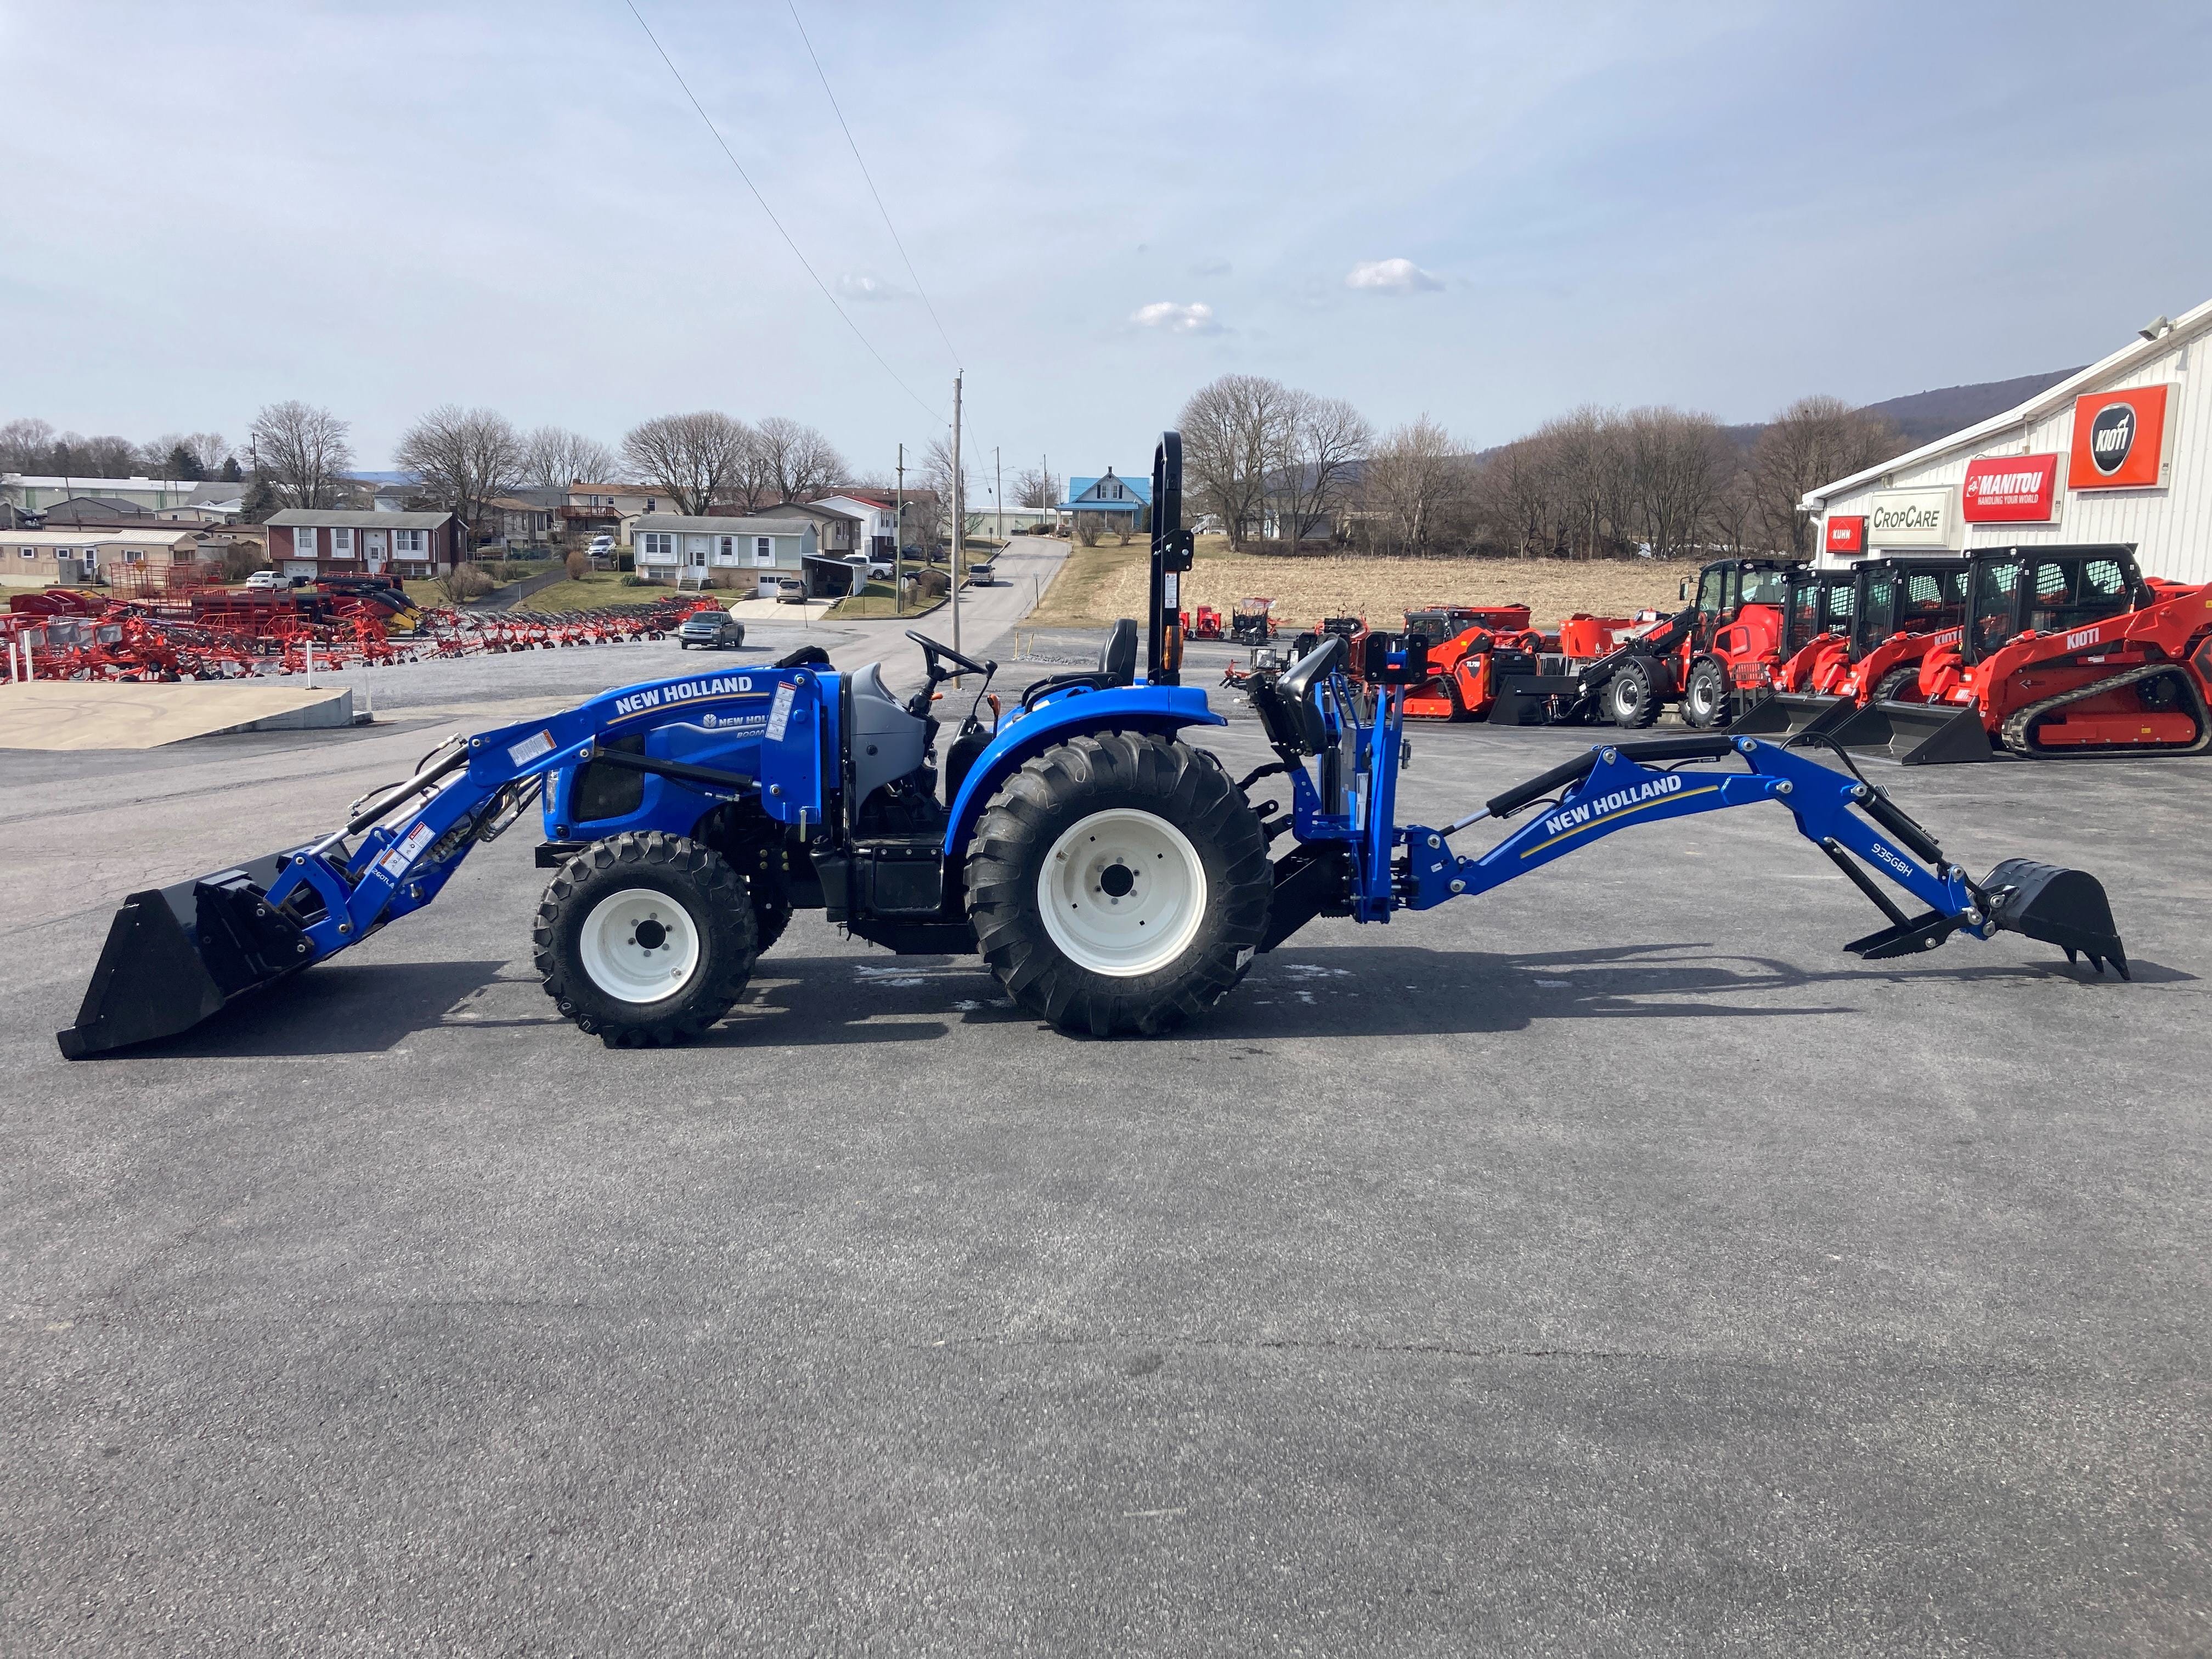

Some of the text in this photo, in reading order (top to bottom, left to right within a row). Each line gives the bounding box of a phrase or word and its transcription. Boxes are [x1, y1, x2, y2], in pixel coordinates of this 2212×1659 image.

[2096, 427, 2129, 452] KIOTI
[1979, 472, 2043, 495] MANITOU
[1978, 494, 2039, 505] HANDLING YOUR WORLD
[1833, 529, 1850, 540] KUHN
[2067, 627, 2100, 650] KIOTI
[616, 676, 752, 715] NEW HOLLAND
[719, 716, 744, 727] NEW
[1545, 774, 1681, 835] NEW HOLLAND
[1871, 843, 1913, 877] 935GBH
[372, 868, 394, 889] 260TLA
